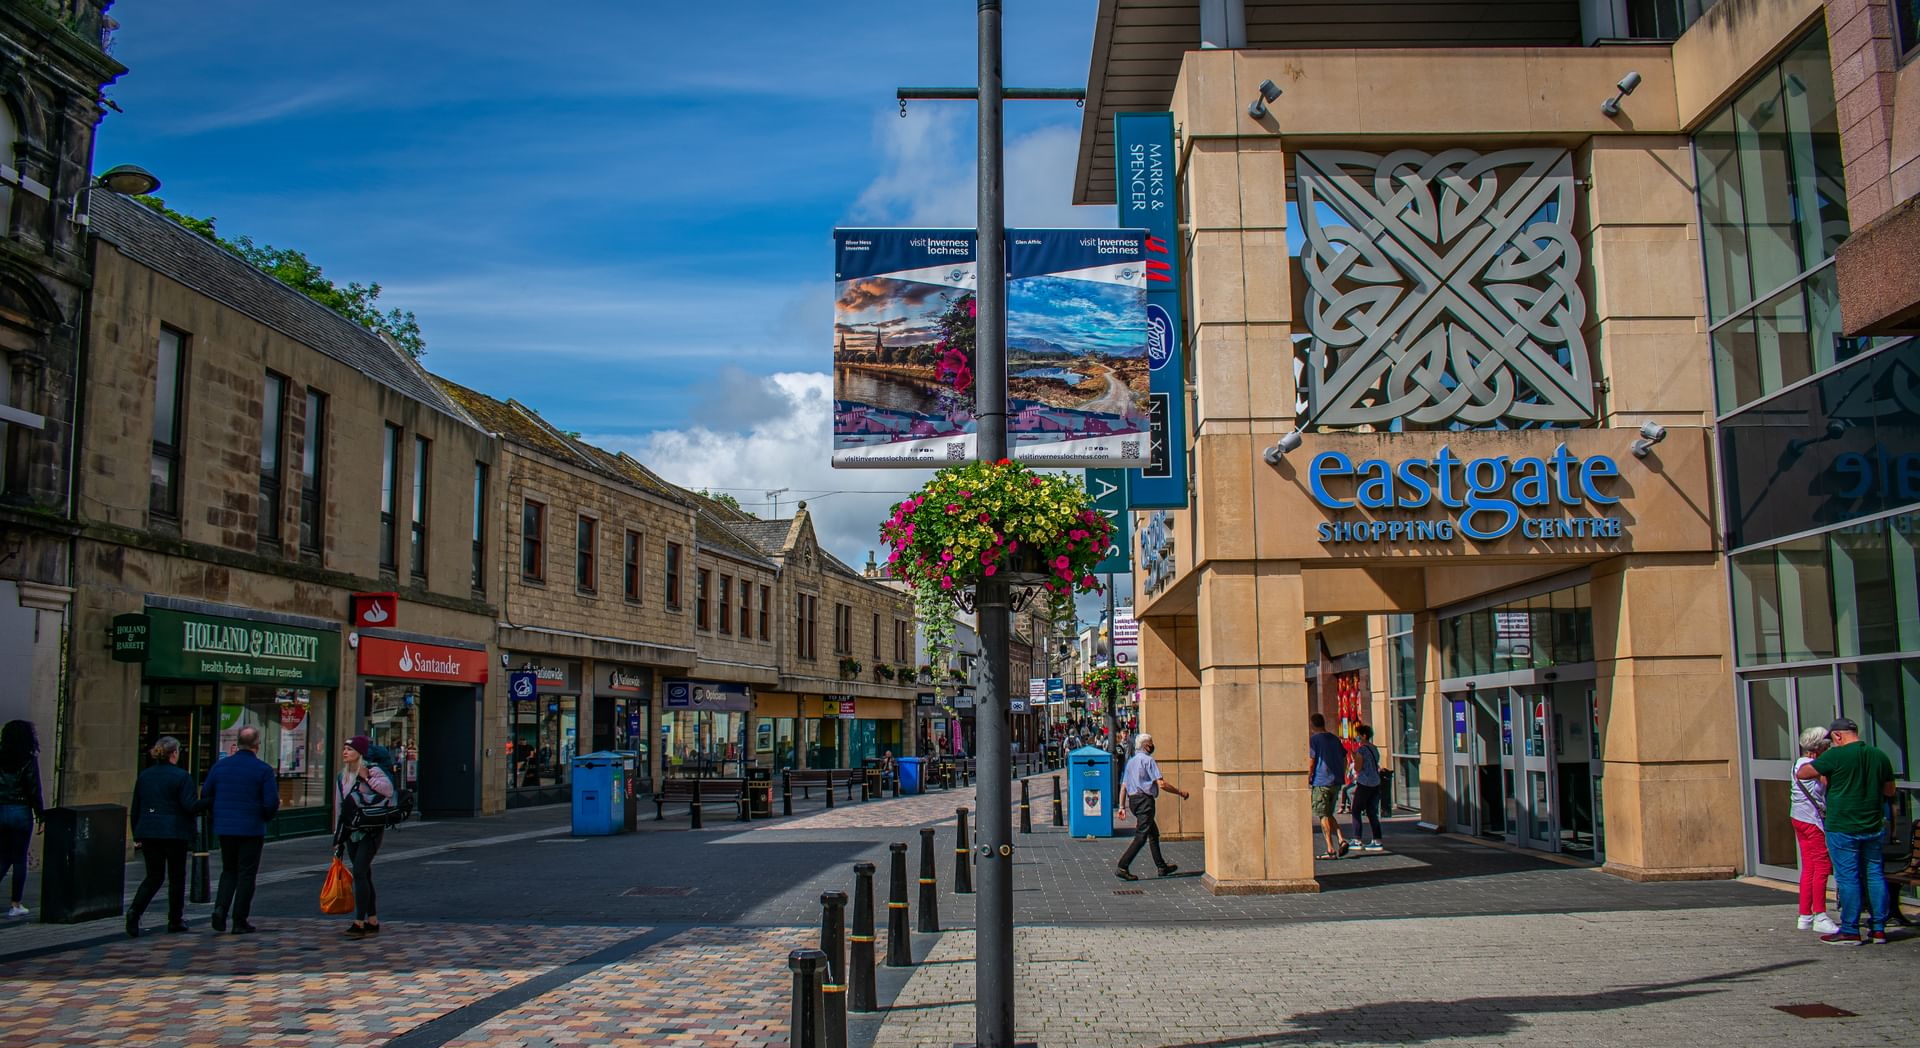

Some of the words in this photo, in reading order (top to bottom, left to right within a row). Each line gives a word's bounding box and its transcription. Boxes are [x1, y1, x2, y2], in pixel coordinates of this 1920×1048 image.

[1130, 143, 1146, 210] SPENCER
[1149, 143, 1164, 196] MARKS
[1151, 199, 1164, 210] &
[910, 238, 927, 247] visit
[927, 238, 969, 247] Inverness
[927, 246, 948, 255] loch
[948, 247, 969, 255] ness
[1080, 238, 1096, 247] visit
[1097, 237, 1138, 247] Inverness
[1097, 246, 1118, 254] loch
[1147, 317, 1167, 360] Boots
[1150, 400, 1163, 471] NEXT
[1308, 442, 1620, 539] eastgate
[1316, 520, 1453, 542] SHOPPING
[1521, 517, 1622, 539] CENTRE
[117, 625, 146, 635] HOLLAND
[116, 641, 145, 650] BARRETT
[182, 620, 249, 651] HOLLAND
[250, 628, 263, 658] &
[264, 630, 319, 662] BARRETT
[201, 660, 224, 673] health
[224, 661, 244, 675] foods
[245, 664, 250, 674] &
[252, 665, 275, 676] natural
[414, 653, 461, 675] Santander
